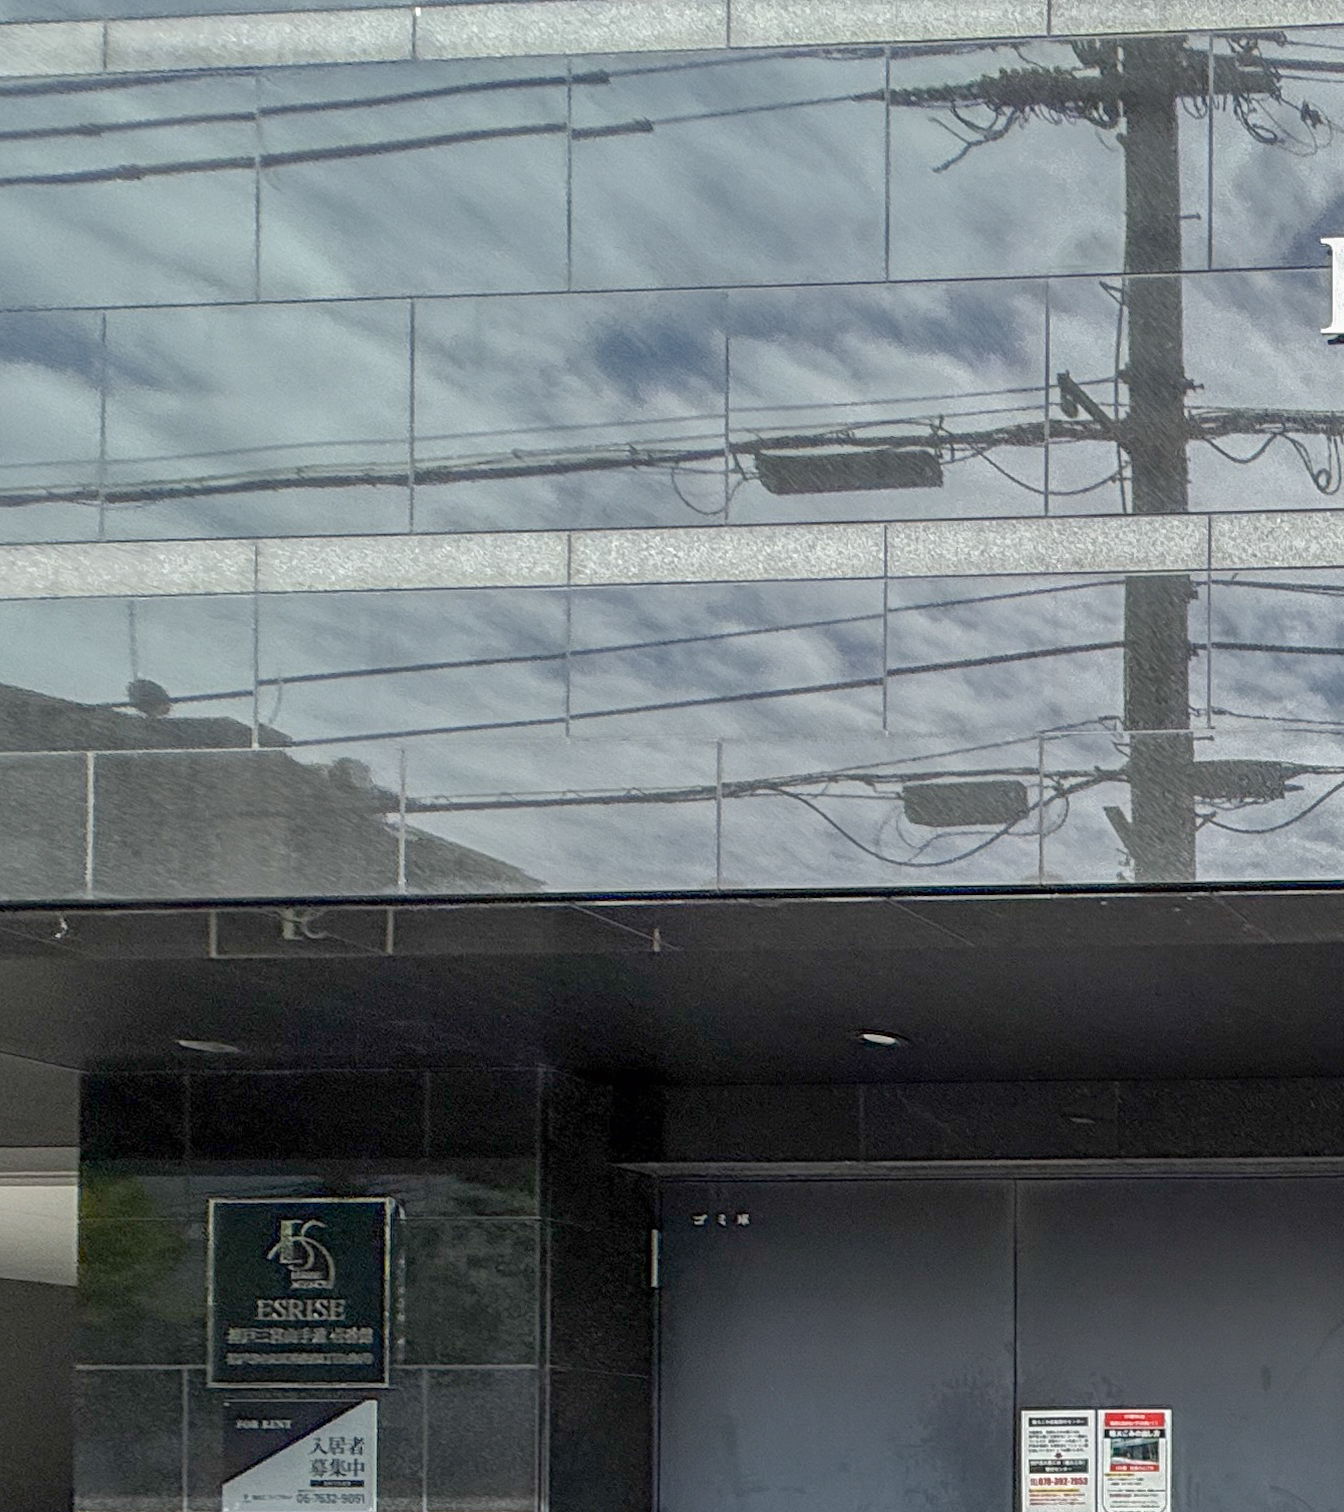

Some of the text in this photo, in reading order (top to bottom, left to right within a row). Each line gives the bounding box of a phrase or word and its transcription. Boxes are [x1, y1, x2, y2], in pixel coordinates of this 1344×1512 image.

[255, 1299, 346, 1320] ESRISE
[236, 1419, 292, 1429] FOR RENT
[308, 1437, 364, 1455] 入居者
[311, 1459, 365, 1477] 募集中
